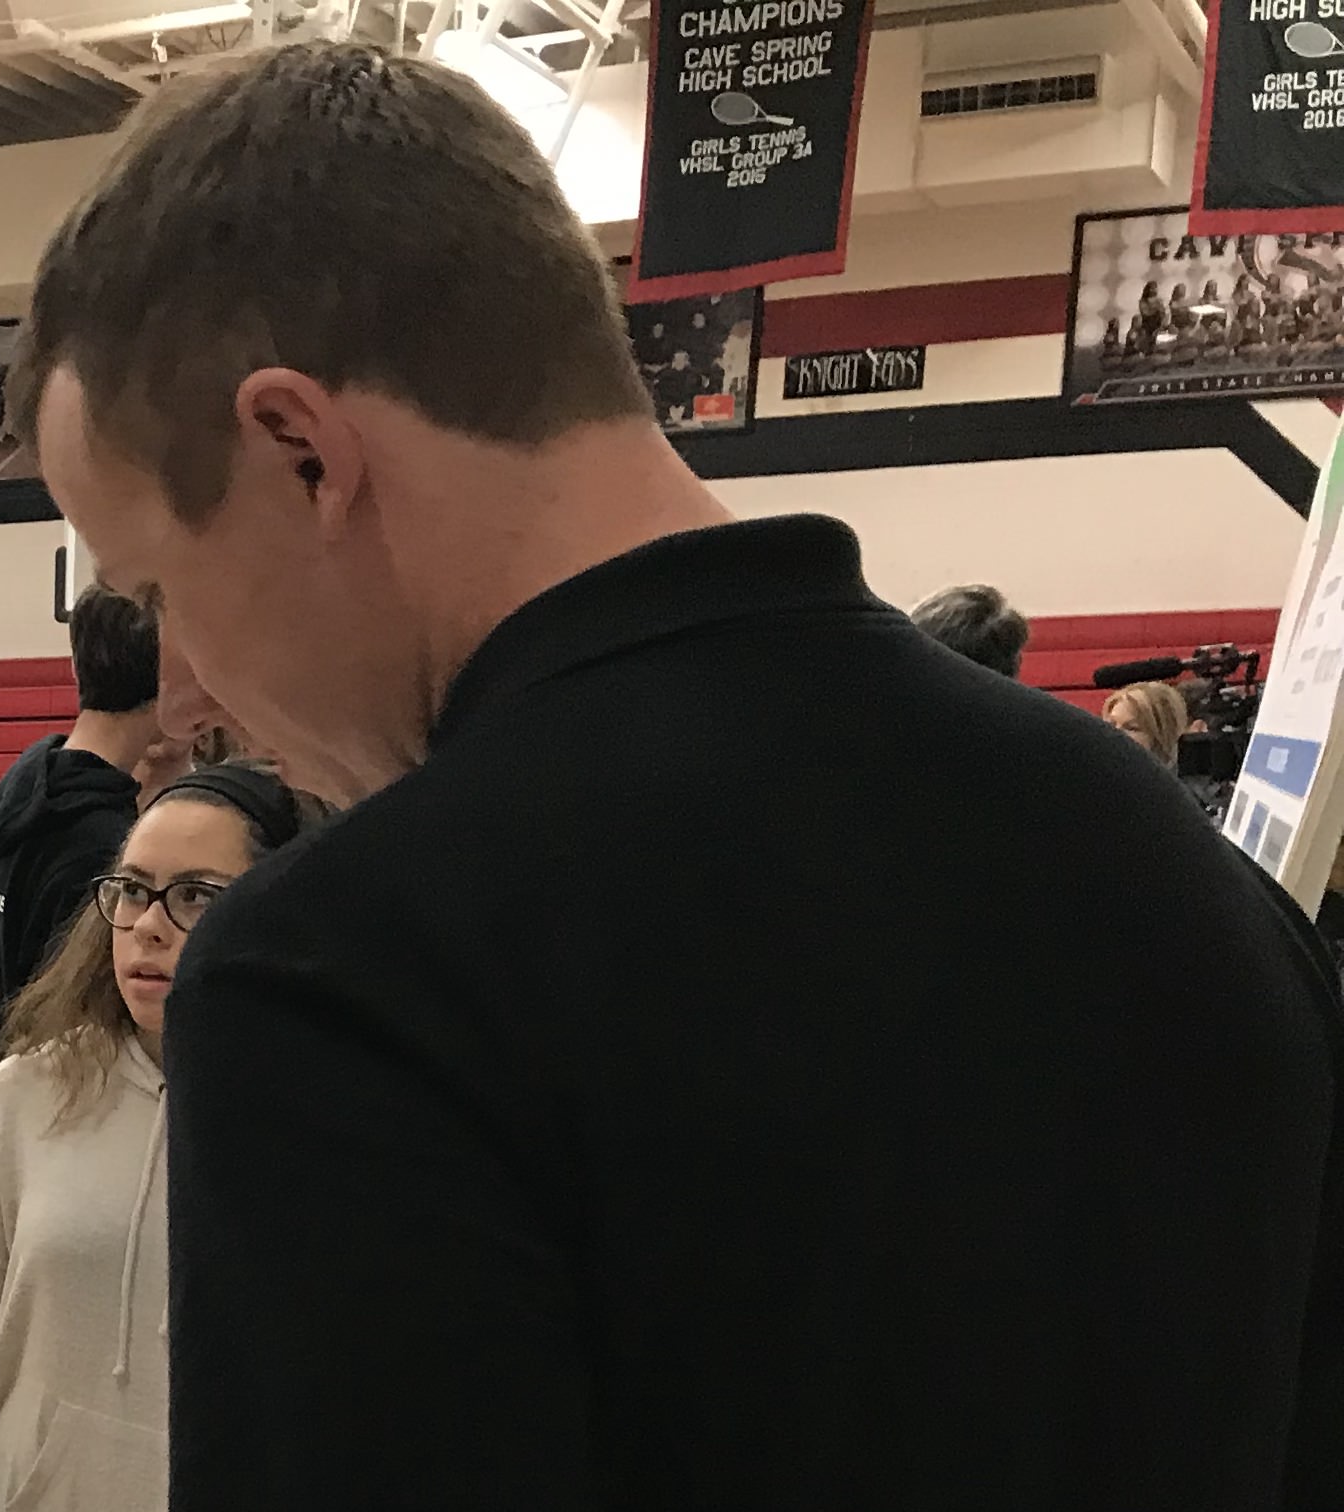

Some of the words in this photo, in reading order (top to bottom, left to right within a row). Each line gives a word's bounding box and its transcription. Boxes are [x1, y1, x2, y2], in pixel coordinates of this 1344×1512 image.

[680, 0, 843, 37] CHAMPIONS
[1250, 0, 1305, 21] HIGH
[684, 44, 741, 69] CAVE
[751, 31, 833, 62] SPRING
[679, 70, 731, 92] HIGH
[742, 55, 832, 88] SCHOOL
[1264, 71, 1317, 92] GIRLS
[1252, 91, 1299, 111] VHSL
[1308, 89, 1344, 108] GRO
[692, 136, 740, 157] GIRLS
[749, 125, 806, 151] TENNIS
[680, 156, 724, 174] VHSL
[732, 148, 787, 169] GROUP
[792, 142, 812, 160] 3A
[797, 353, 861, 393] KNIGHT
